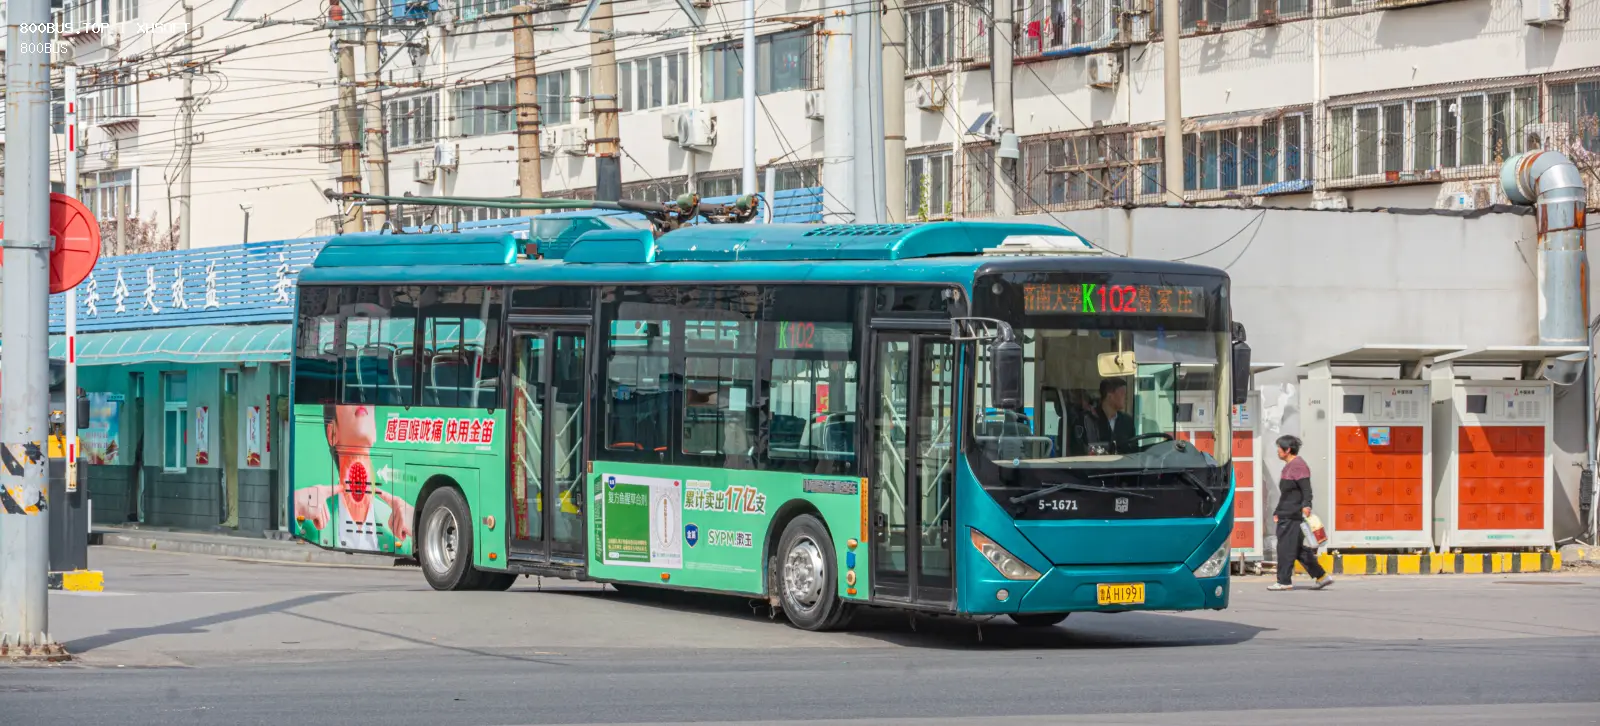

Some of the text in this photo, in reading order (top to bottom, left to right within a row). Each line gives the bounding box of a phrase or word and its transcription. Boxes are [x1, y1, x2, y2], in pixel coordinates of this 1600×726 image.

[1082, 283, 1137, 313] K102
[779, 321, 815, 349] K102
[385, 418, 495, 443] 感冒喉咙痛 快用金笛
[684, 486, 766, 513] 累计卖出17亿支
[1038, 499, 1079, 511] 5-1671
